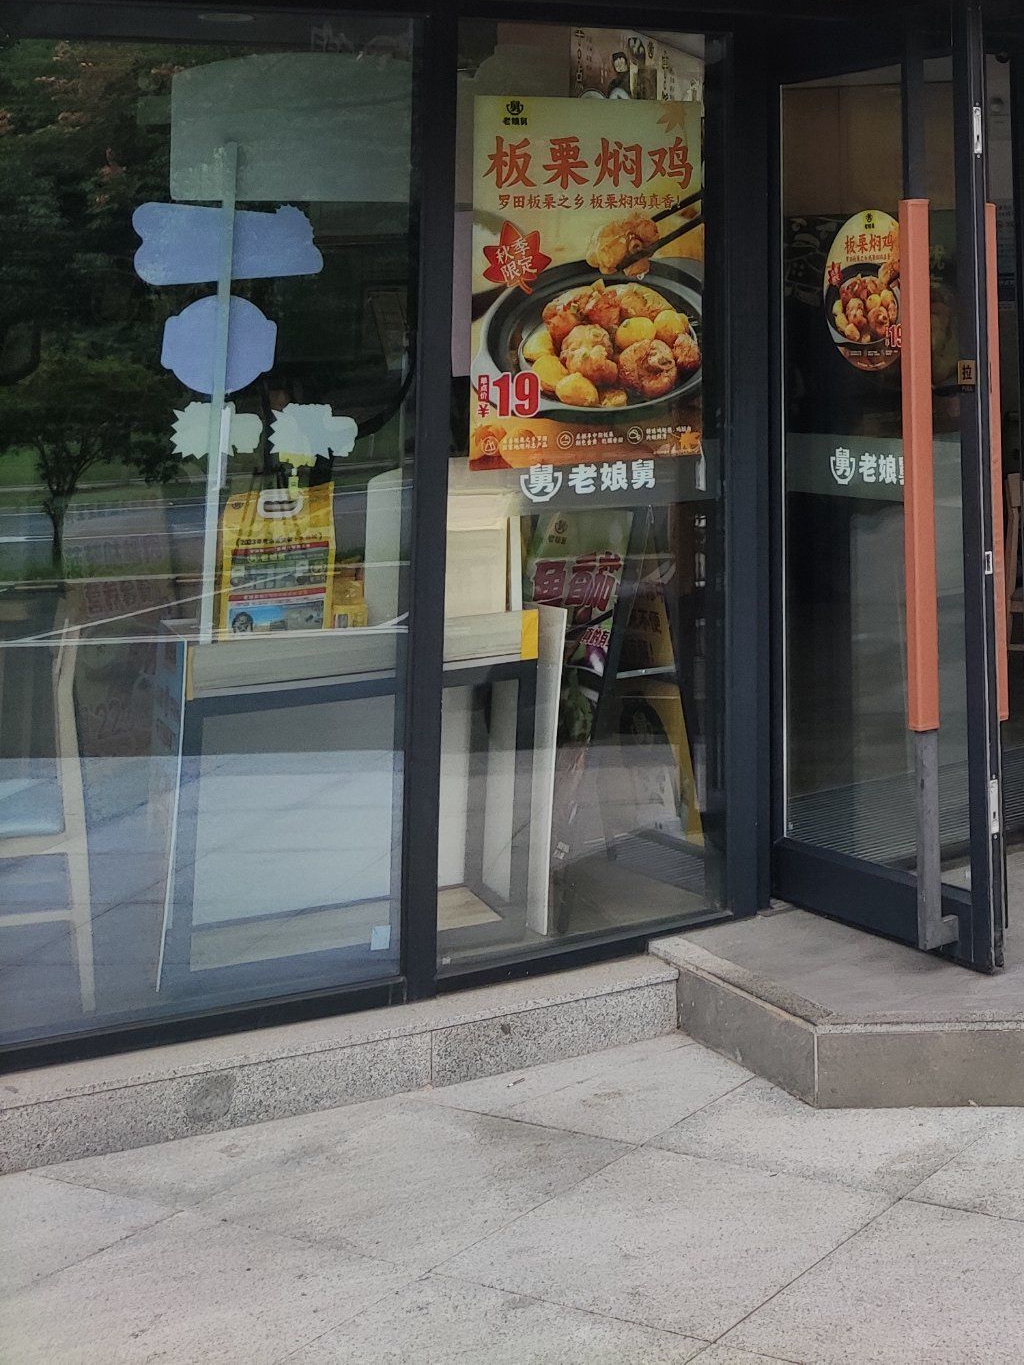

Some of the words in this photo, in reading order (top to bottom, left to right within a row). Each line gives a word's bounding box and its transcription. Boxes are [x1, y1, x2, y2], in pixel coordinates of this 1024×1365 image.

[483, 135, 693, 190] 板栗焖鸡
[498, 194, 584, 211] 罗田板栗之乡
[495, 237, 530, 265] 秋季
[844, 233, 894, 256] 板栗焖鸡
[499, 255, 538, 283] 限定
[962, 364, 972, 381] 拉
[568, 459, 656, 495] 老娘舅
[858, 452, 904, 485] 老娘
